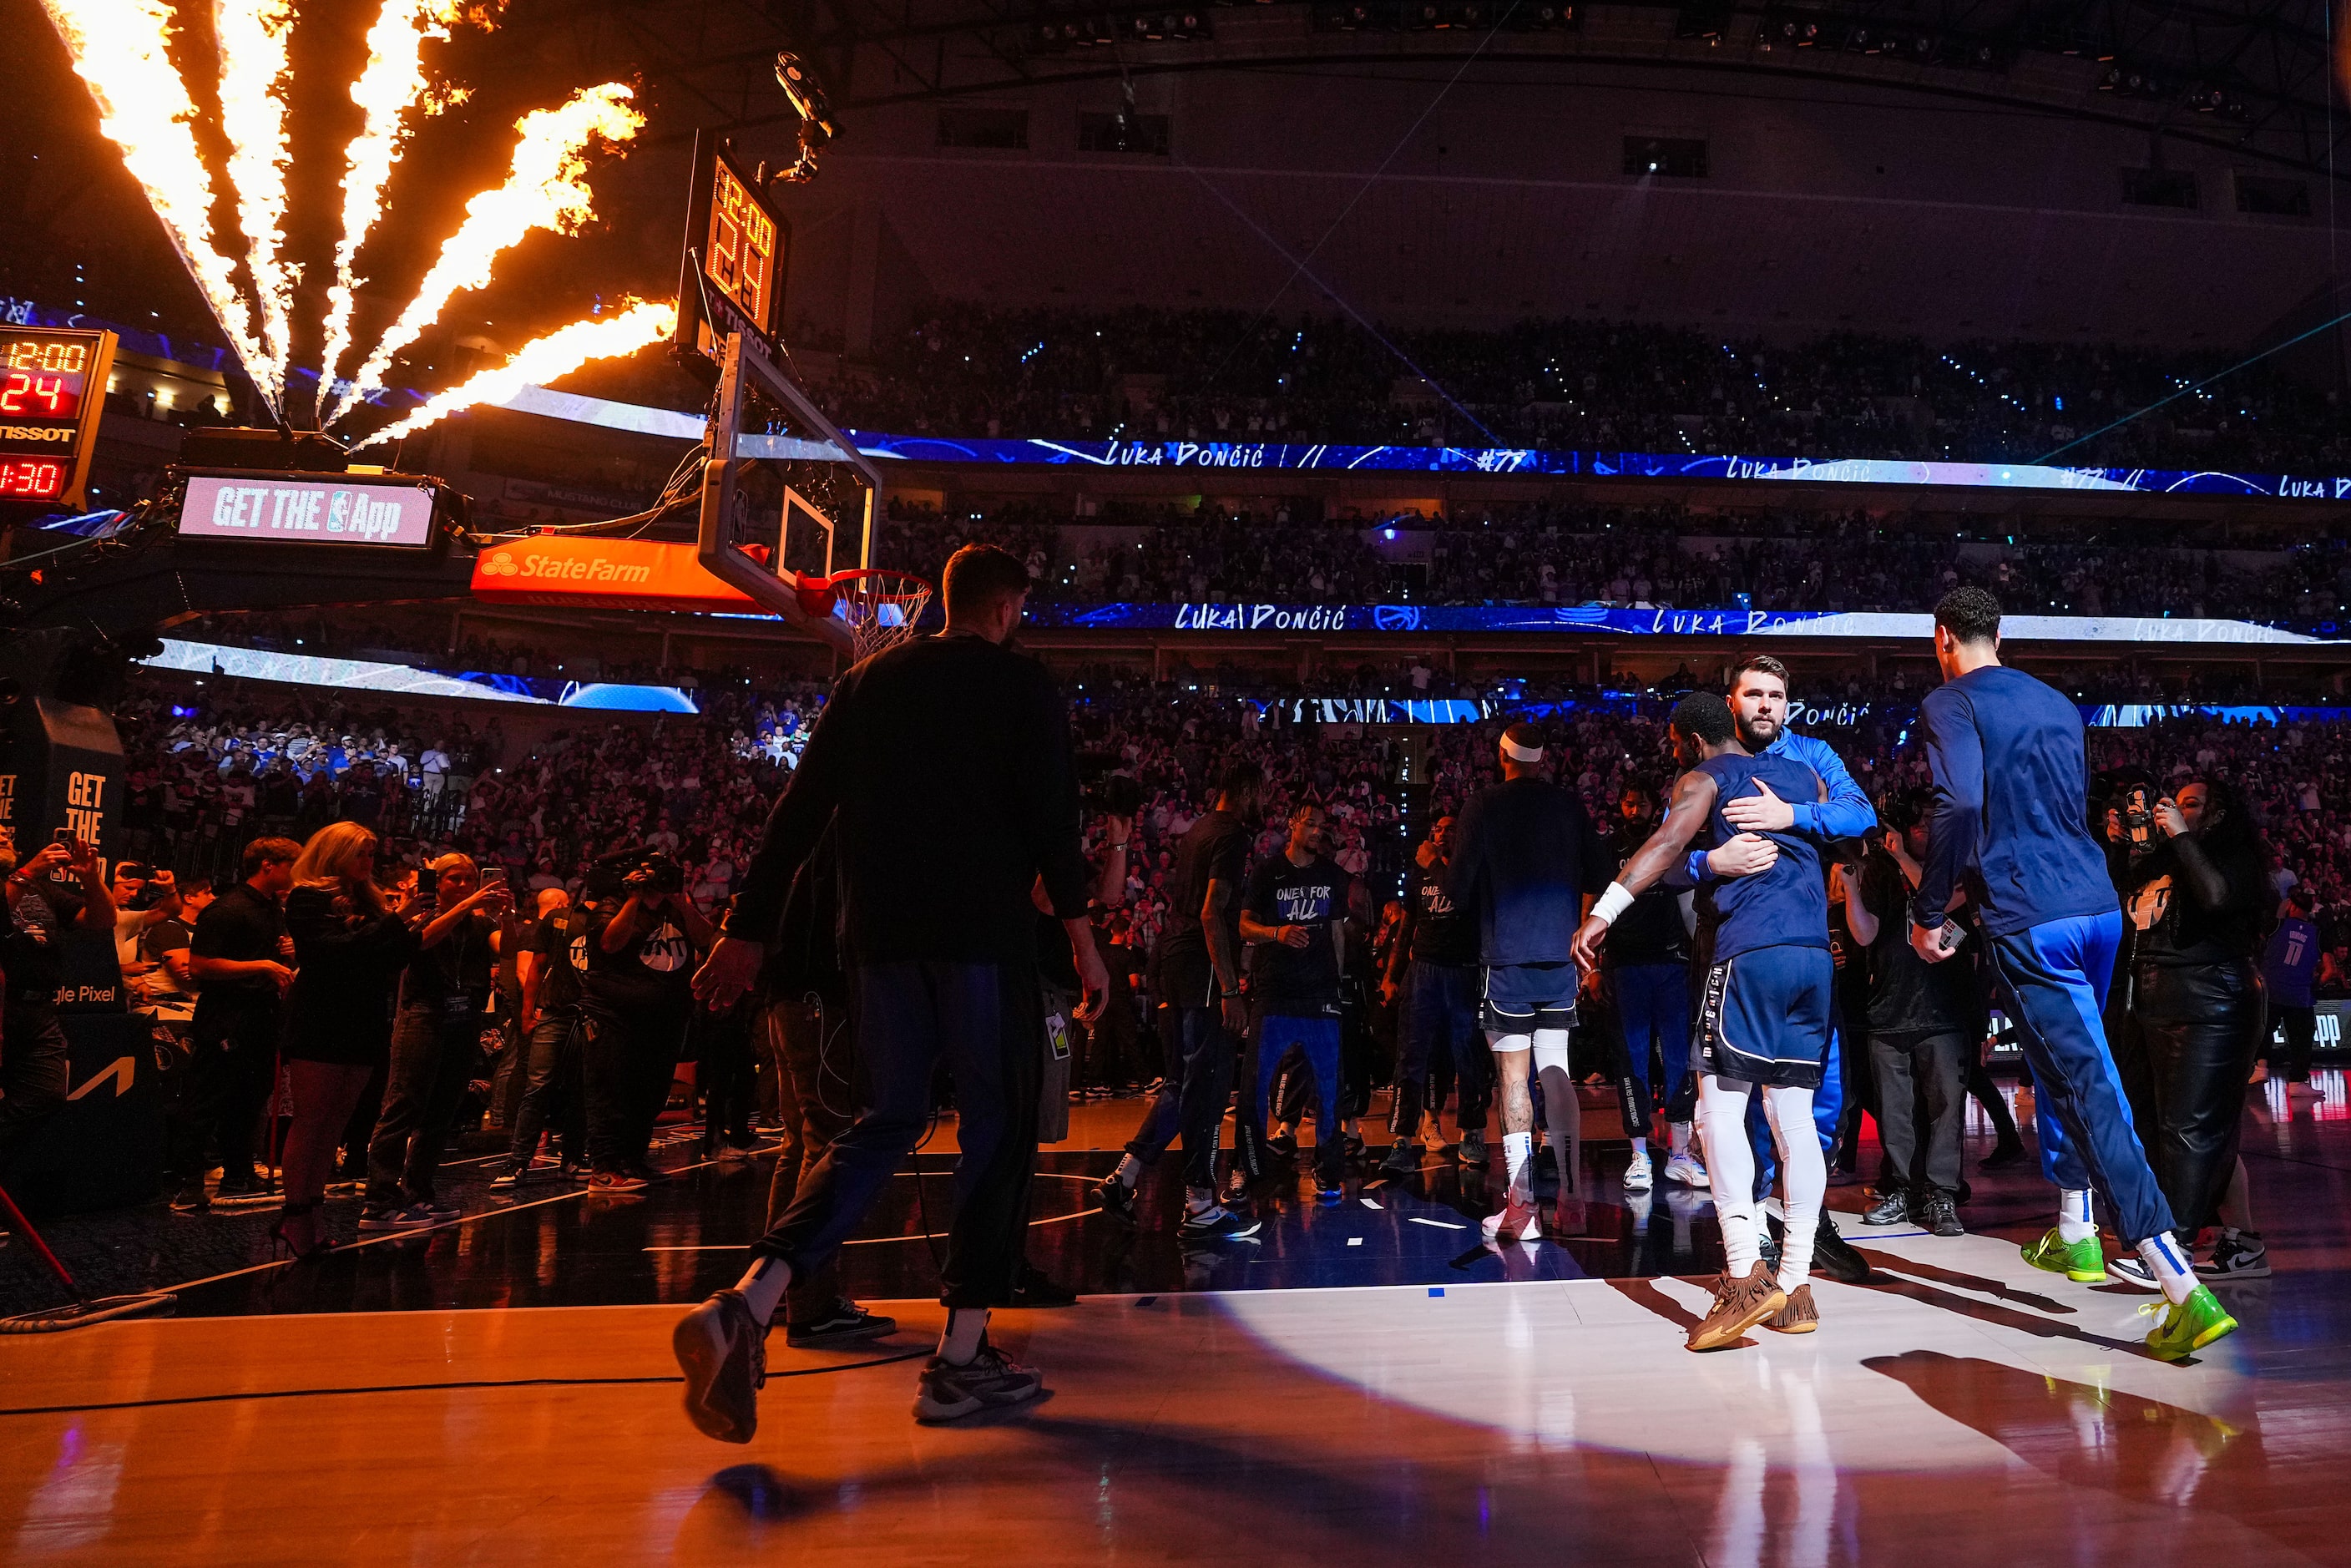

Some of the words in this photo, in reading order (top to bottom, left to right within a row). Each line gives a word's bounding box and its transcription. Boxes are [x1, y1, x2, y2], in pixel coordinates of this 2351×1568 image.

[8, 342, 86, 372] 12:00
[0, 373, 62, 411] 24
[1105, 441, 1164, 466] LUKA
[1476, 448, 1528, 473] #77
[2278, 475, 2324, 498] LUKA
[212, 486, 270, 528] GET
[271, 488, 326, 531] THE
[348, 492, 402, 541] App
[1652, 609, 1724, 635] LUKA
[68, 771, 107, 808] GET
[65, 807, 104, 846] THE
[1276, 888, 1300, 902] ONE
[1310, 885, 1332, 900] FOR
[1421, 885, 1441, 897] ONE
[2129, 887, 2172, 913] TT
[1286, 898, 1319, 921] ALL
[1428, 895, 1455, 913] ALL
[78, 985, 116, 1003] Pixel
